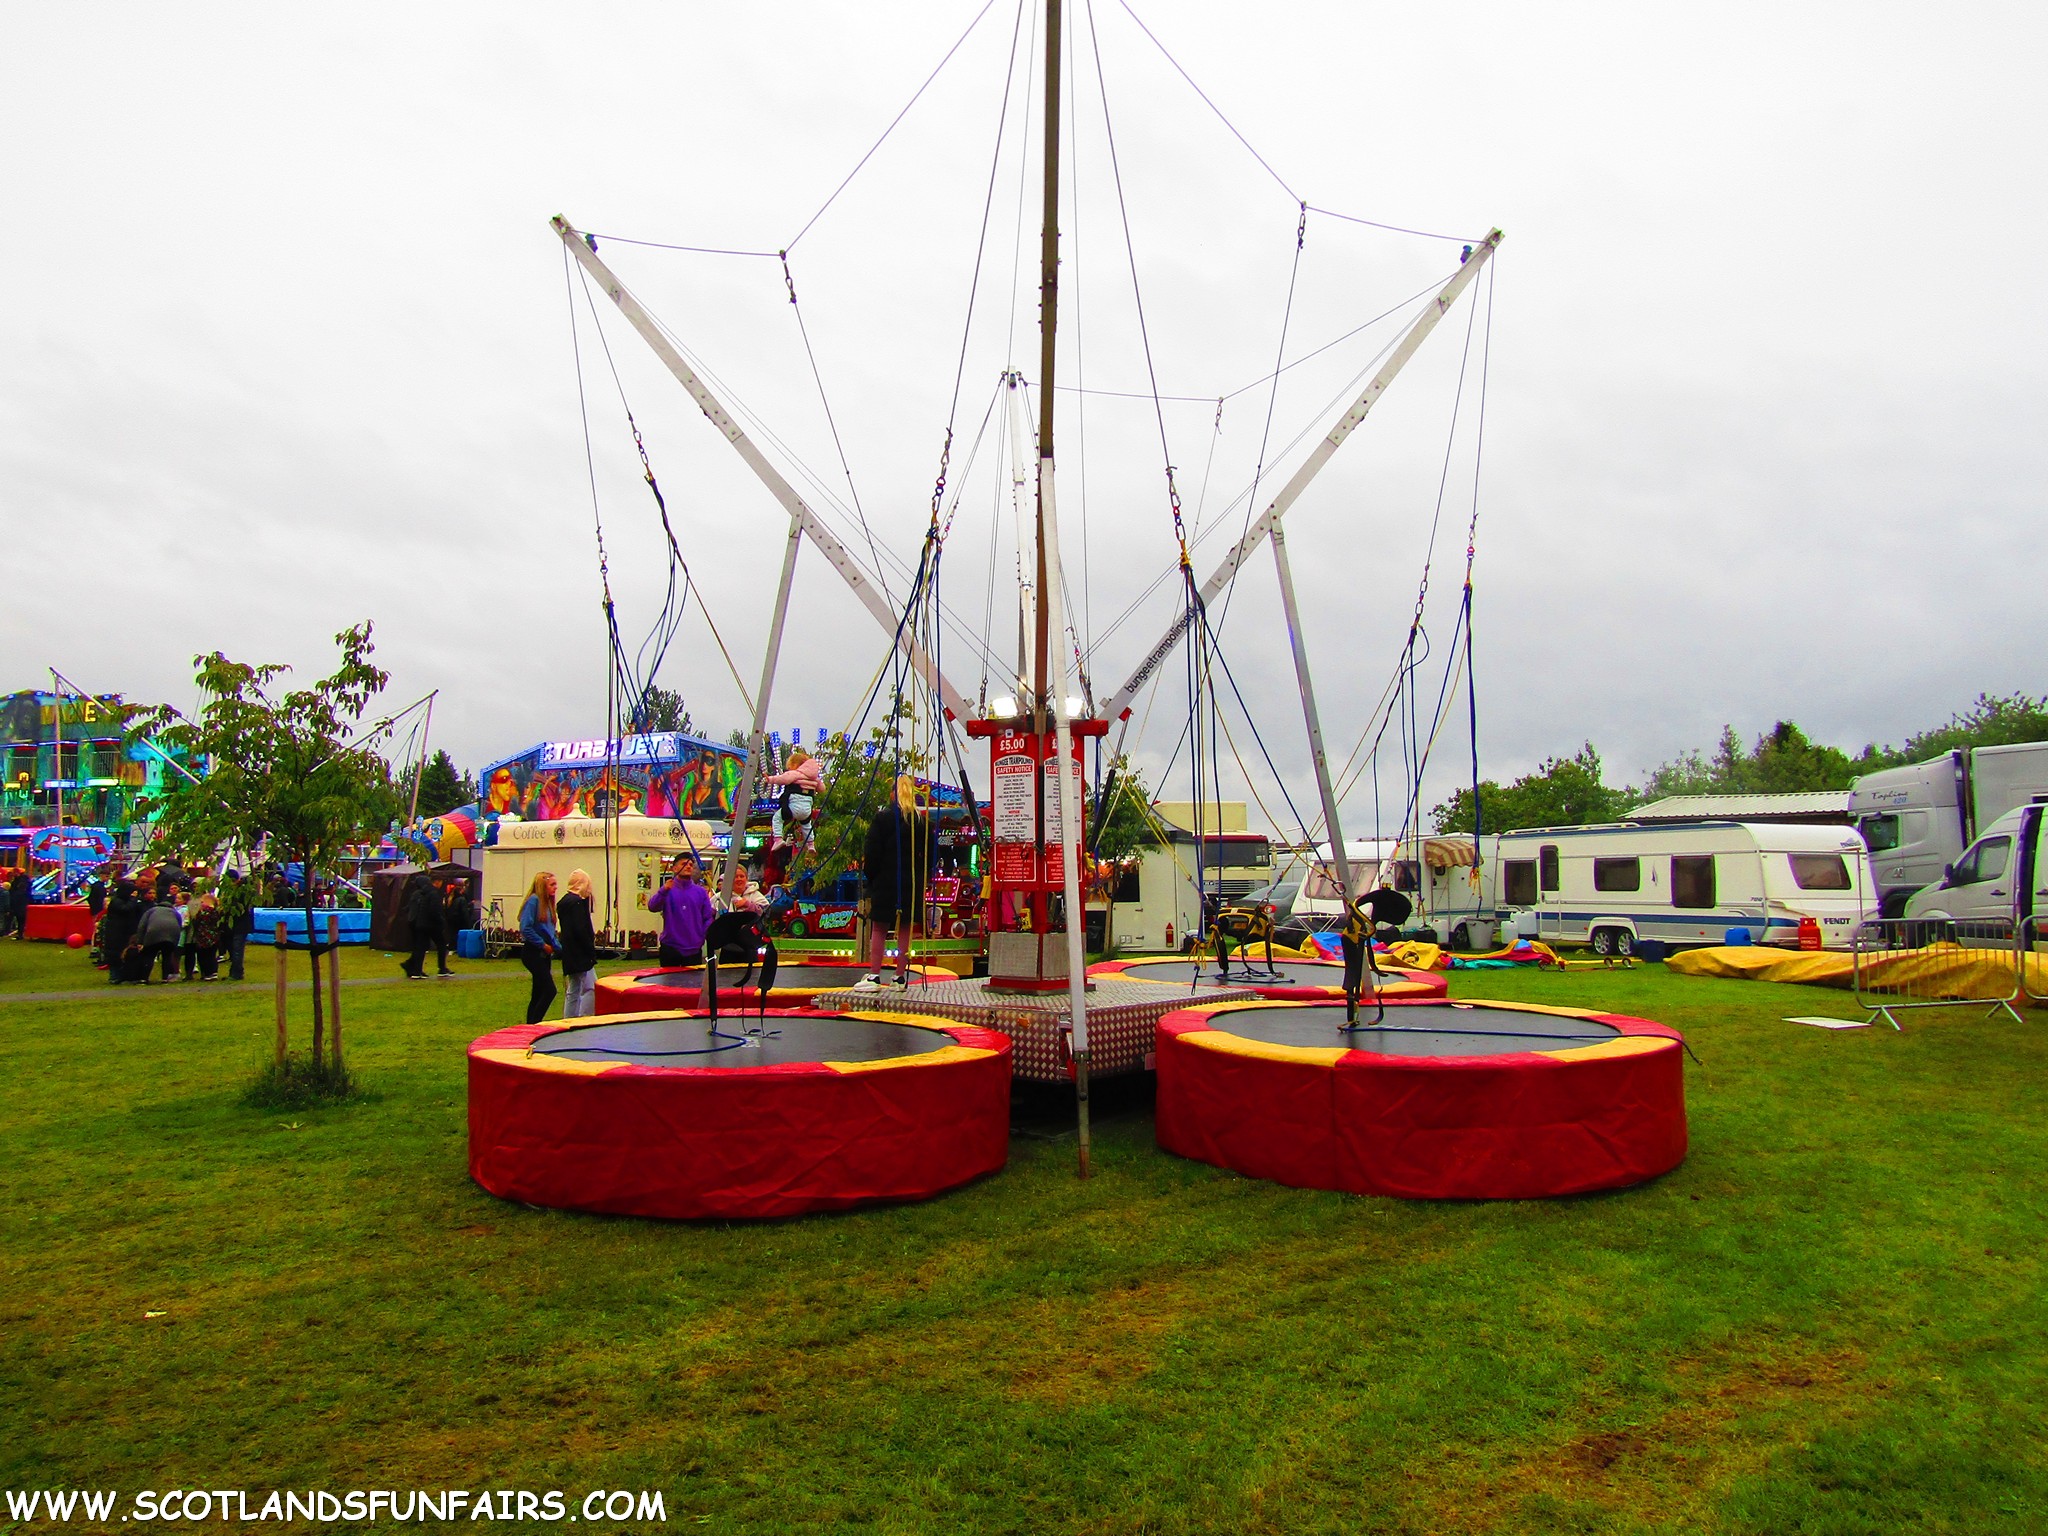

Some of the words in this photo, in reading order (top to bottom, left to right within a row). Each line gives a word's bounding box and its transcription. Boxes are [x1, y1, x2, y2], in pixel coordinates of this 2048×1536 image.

[553, 740, 620, 760] TURBO
[626, 735, 664, 755] JET
[1000, 738, 1025, 751] £5.00
[996, 766, 1014, 774] SAFETY
[1014, 765, 1032, 773] NOTICE
[513, 825, 546, 840] Coffee
[573, 823, 605, 838] Cakes
[641, 828, 667, 838] Coffee
[50, 836, 97, 847] PANES
[819, 910, 854, 928] HAPPY
[1823, 917, 1851, 925] FENDT
